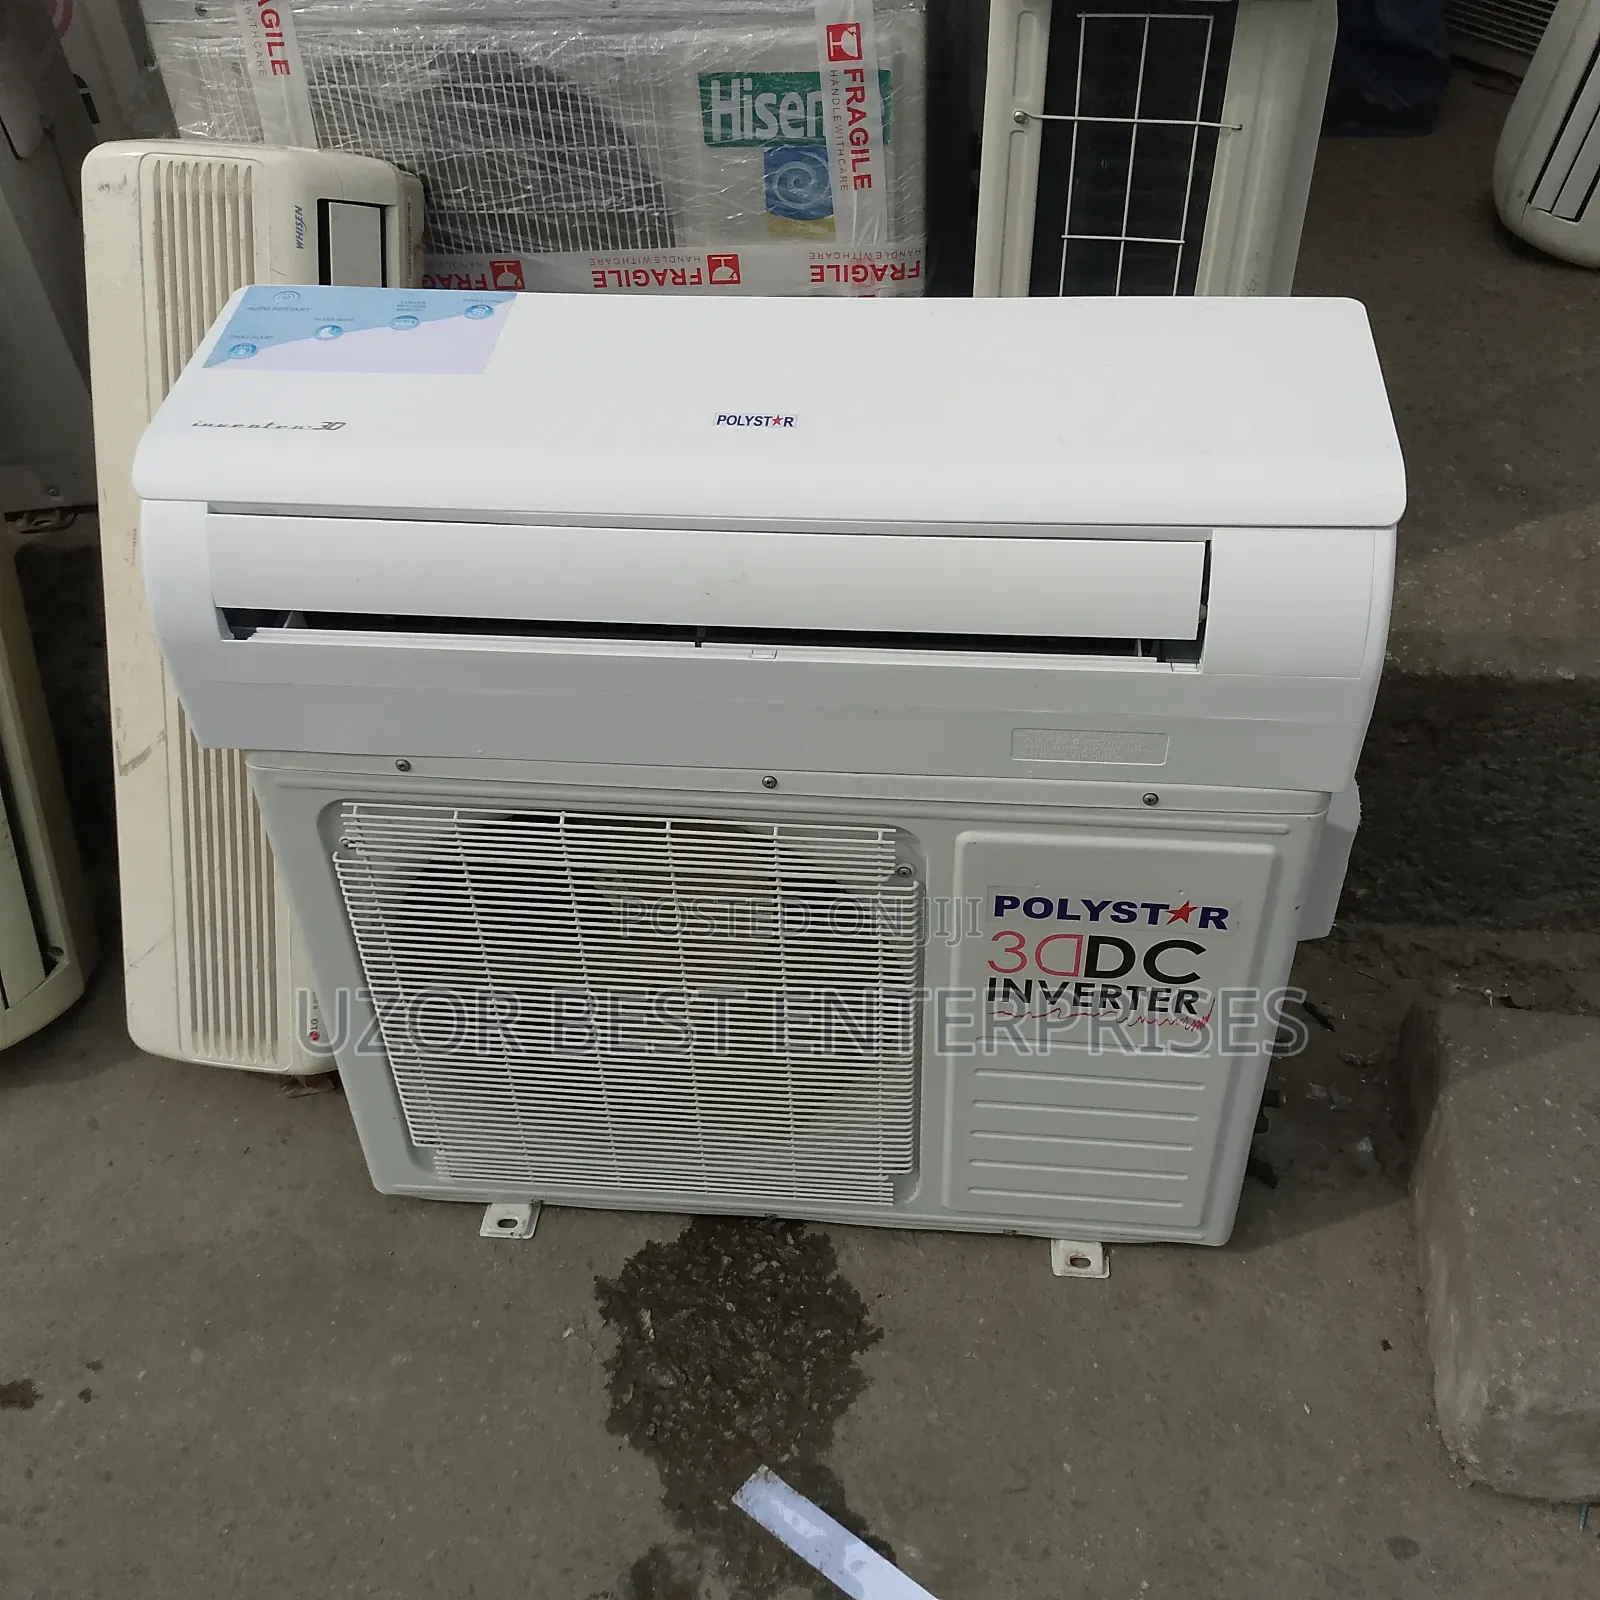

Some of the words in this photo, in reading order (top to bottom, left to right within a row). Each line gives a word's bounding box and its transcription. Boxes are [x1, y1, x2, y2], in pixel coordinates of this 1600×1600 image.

[829, 69, 842, 122] HANDLE
[843, 68, 872, 190] FRAGILE
[294, 204, 305, 250] WHISEN
[654, 255, 701, 264] HANDLE
[809, 260, 920, 283] FRAGILE
[591, 268, 703, 288] FRAGILE
[987, 976, 1200, 1016] INVERTER
[310, 1018, 319, 1030] LG
